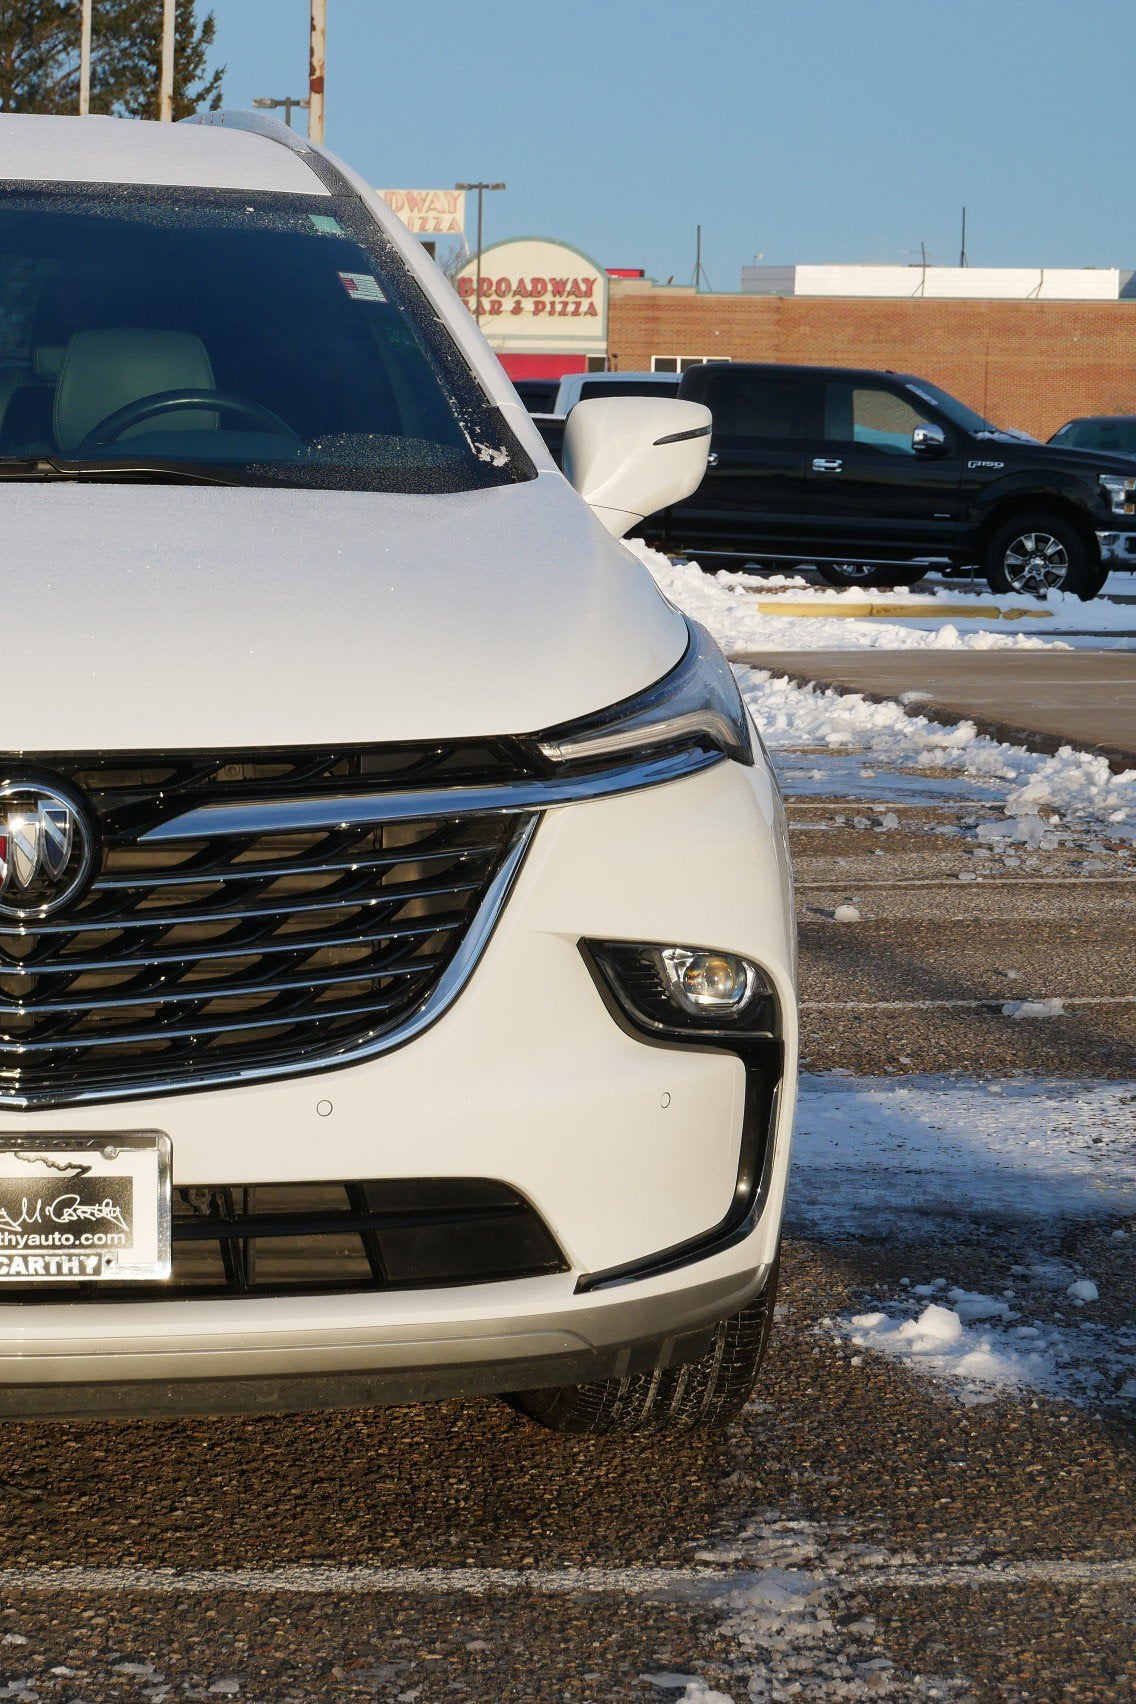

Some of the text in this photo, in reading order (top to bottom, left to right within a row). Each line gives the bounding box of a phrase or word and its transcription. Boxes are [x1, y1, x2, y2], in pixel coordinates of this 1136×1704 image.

[458, 277, 598, 298] BROADWAY
[511, 300, 523, 315] &
[533, 301, 598, 317] PIZZA
